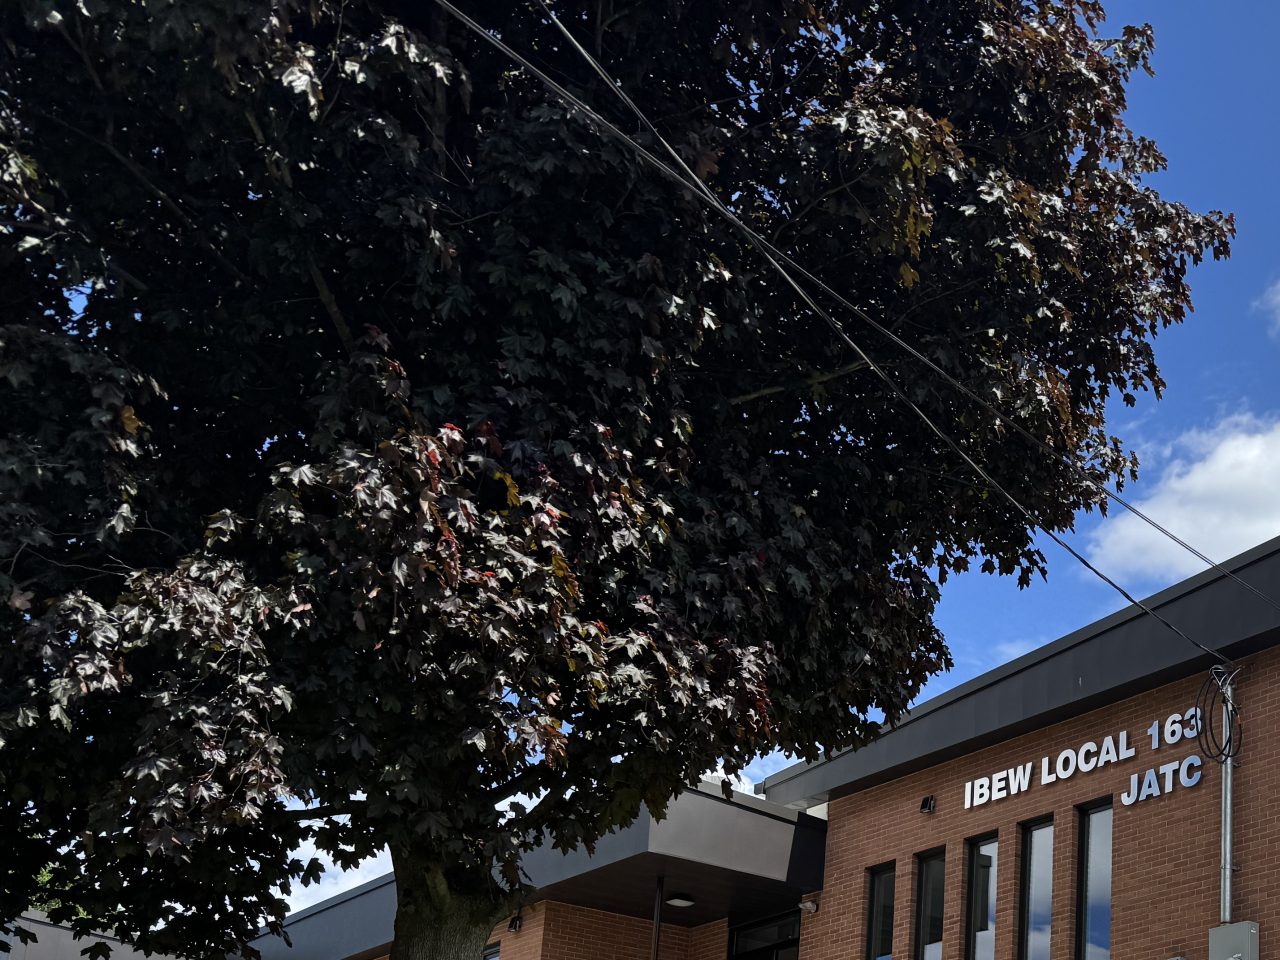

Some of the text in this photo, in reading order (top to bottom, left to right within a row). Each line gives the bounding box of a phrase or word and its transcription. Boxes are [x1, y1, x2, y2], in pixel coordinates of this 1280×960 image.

[964, 706, 1203, 810] IBEW LOCAL 163
[1120, 755, 1203, 807] JATC
